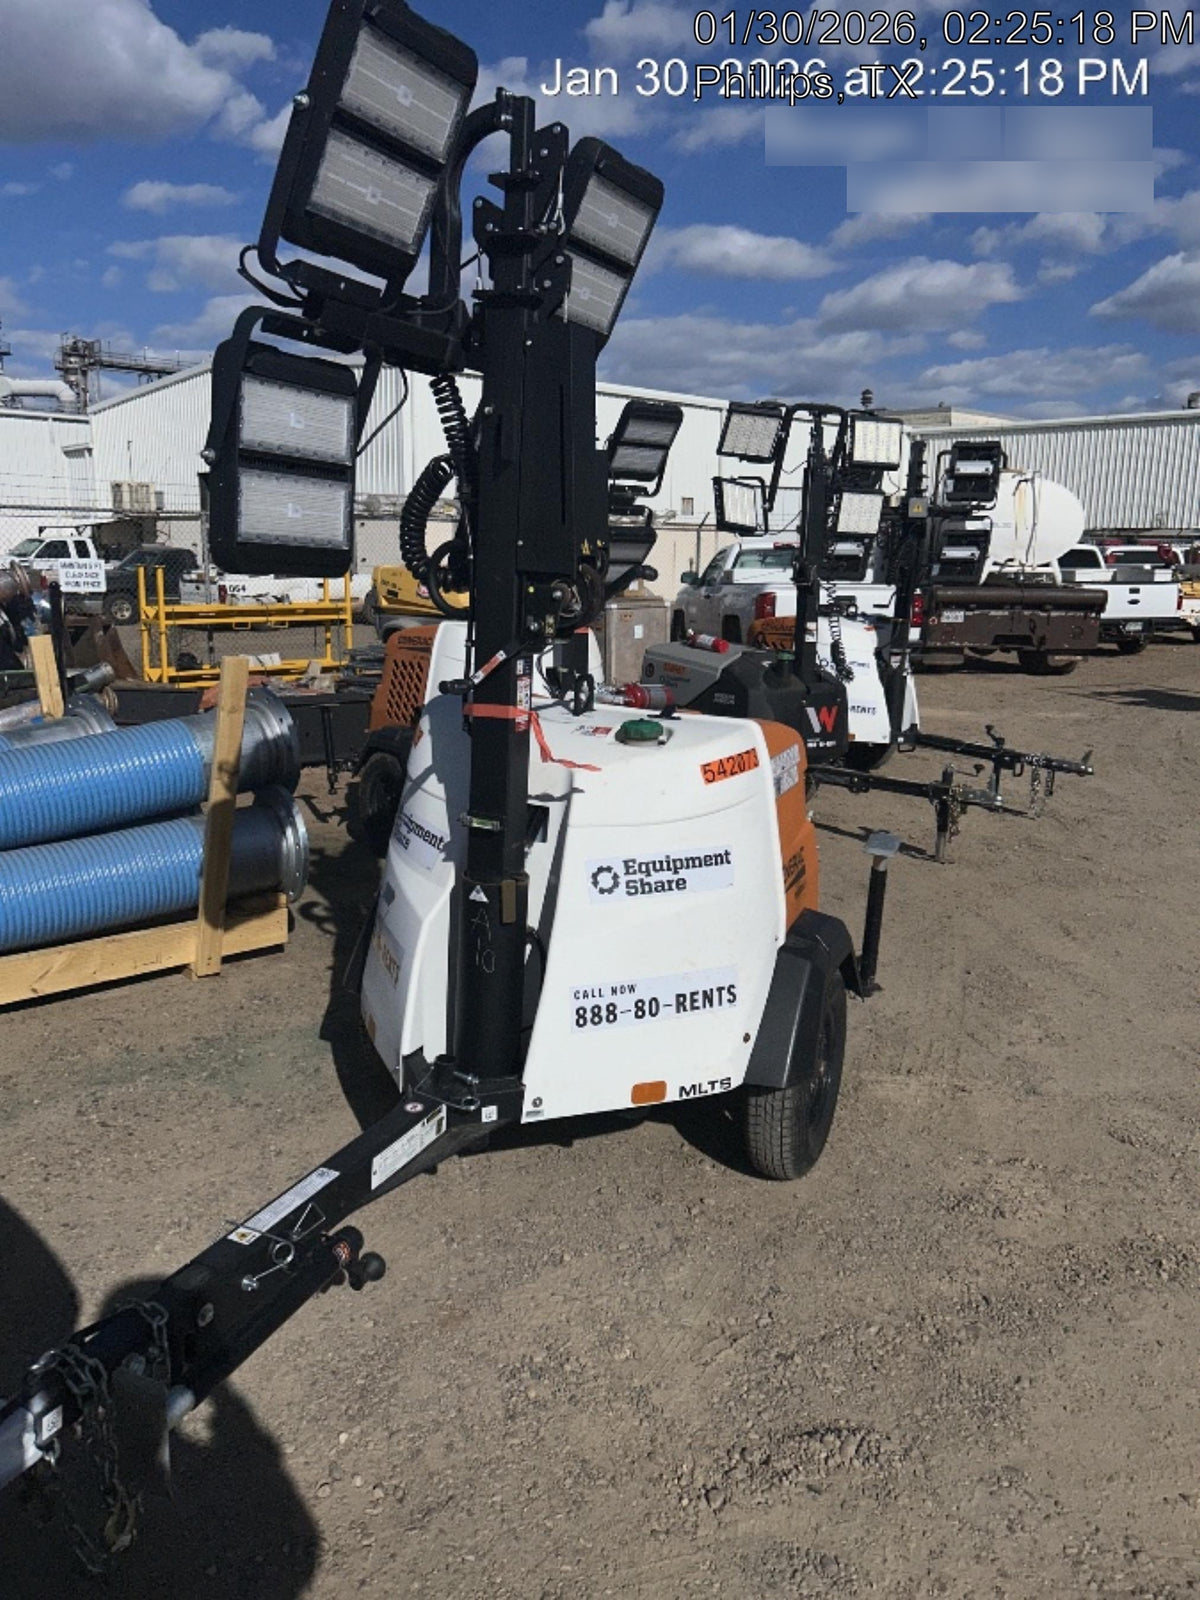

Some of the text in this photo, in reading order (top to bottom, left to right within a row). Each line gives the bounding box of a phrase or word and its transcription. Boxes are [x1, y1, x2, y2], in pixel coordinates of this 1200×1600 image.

[622, 849, 732, 877] Equipment
[625, 877, 687, 896] Share
[573, 984, 638, 1000] CALL NOW
[575, 984, 738, 1028] 888-80-RENTS
[678, 1077, 732, 1098] MLTS
